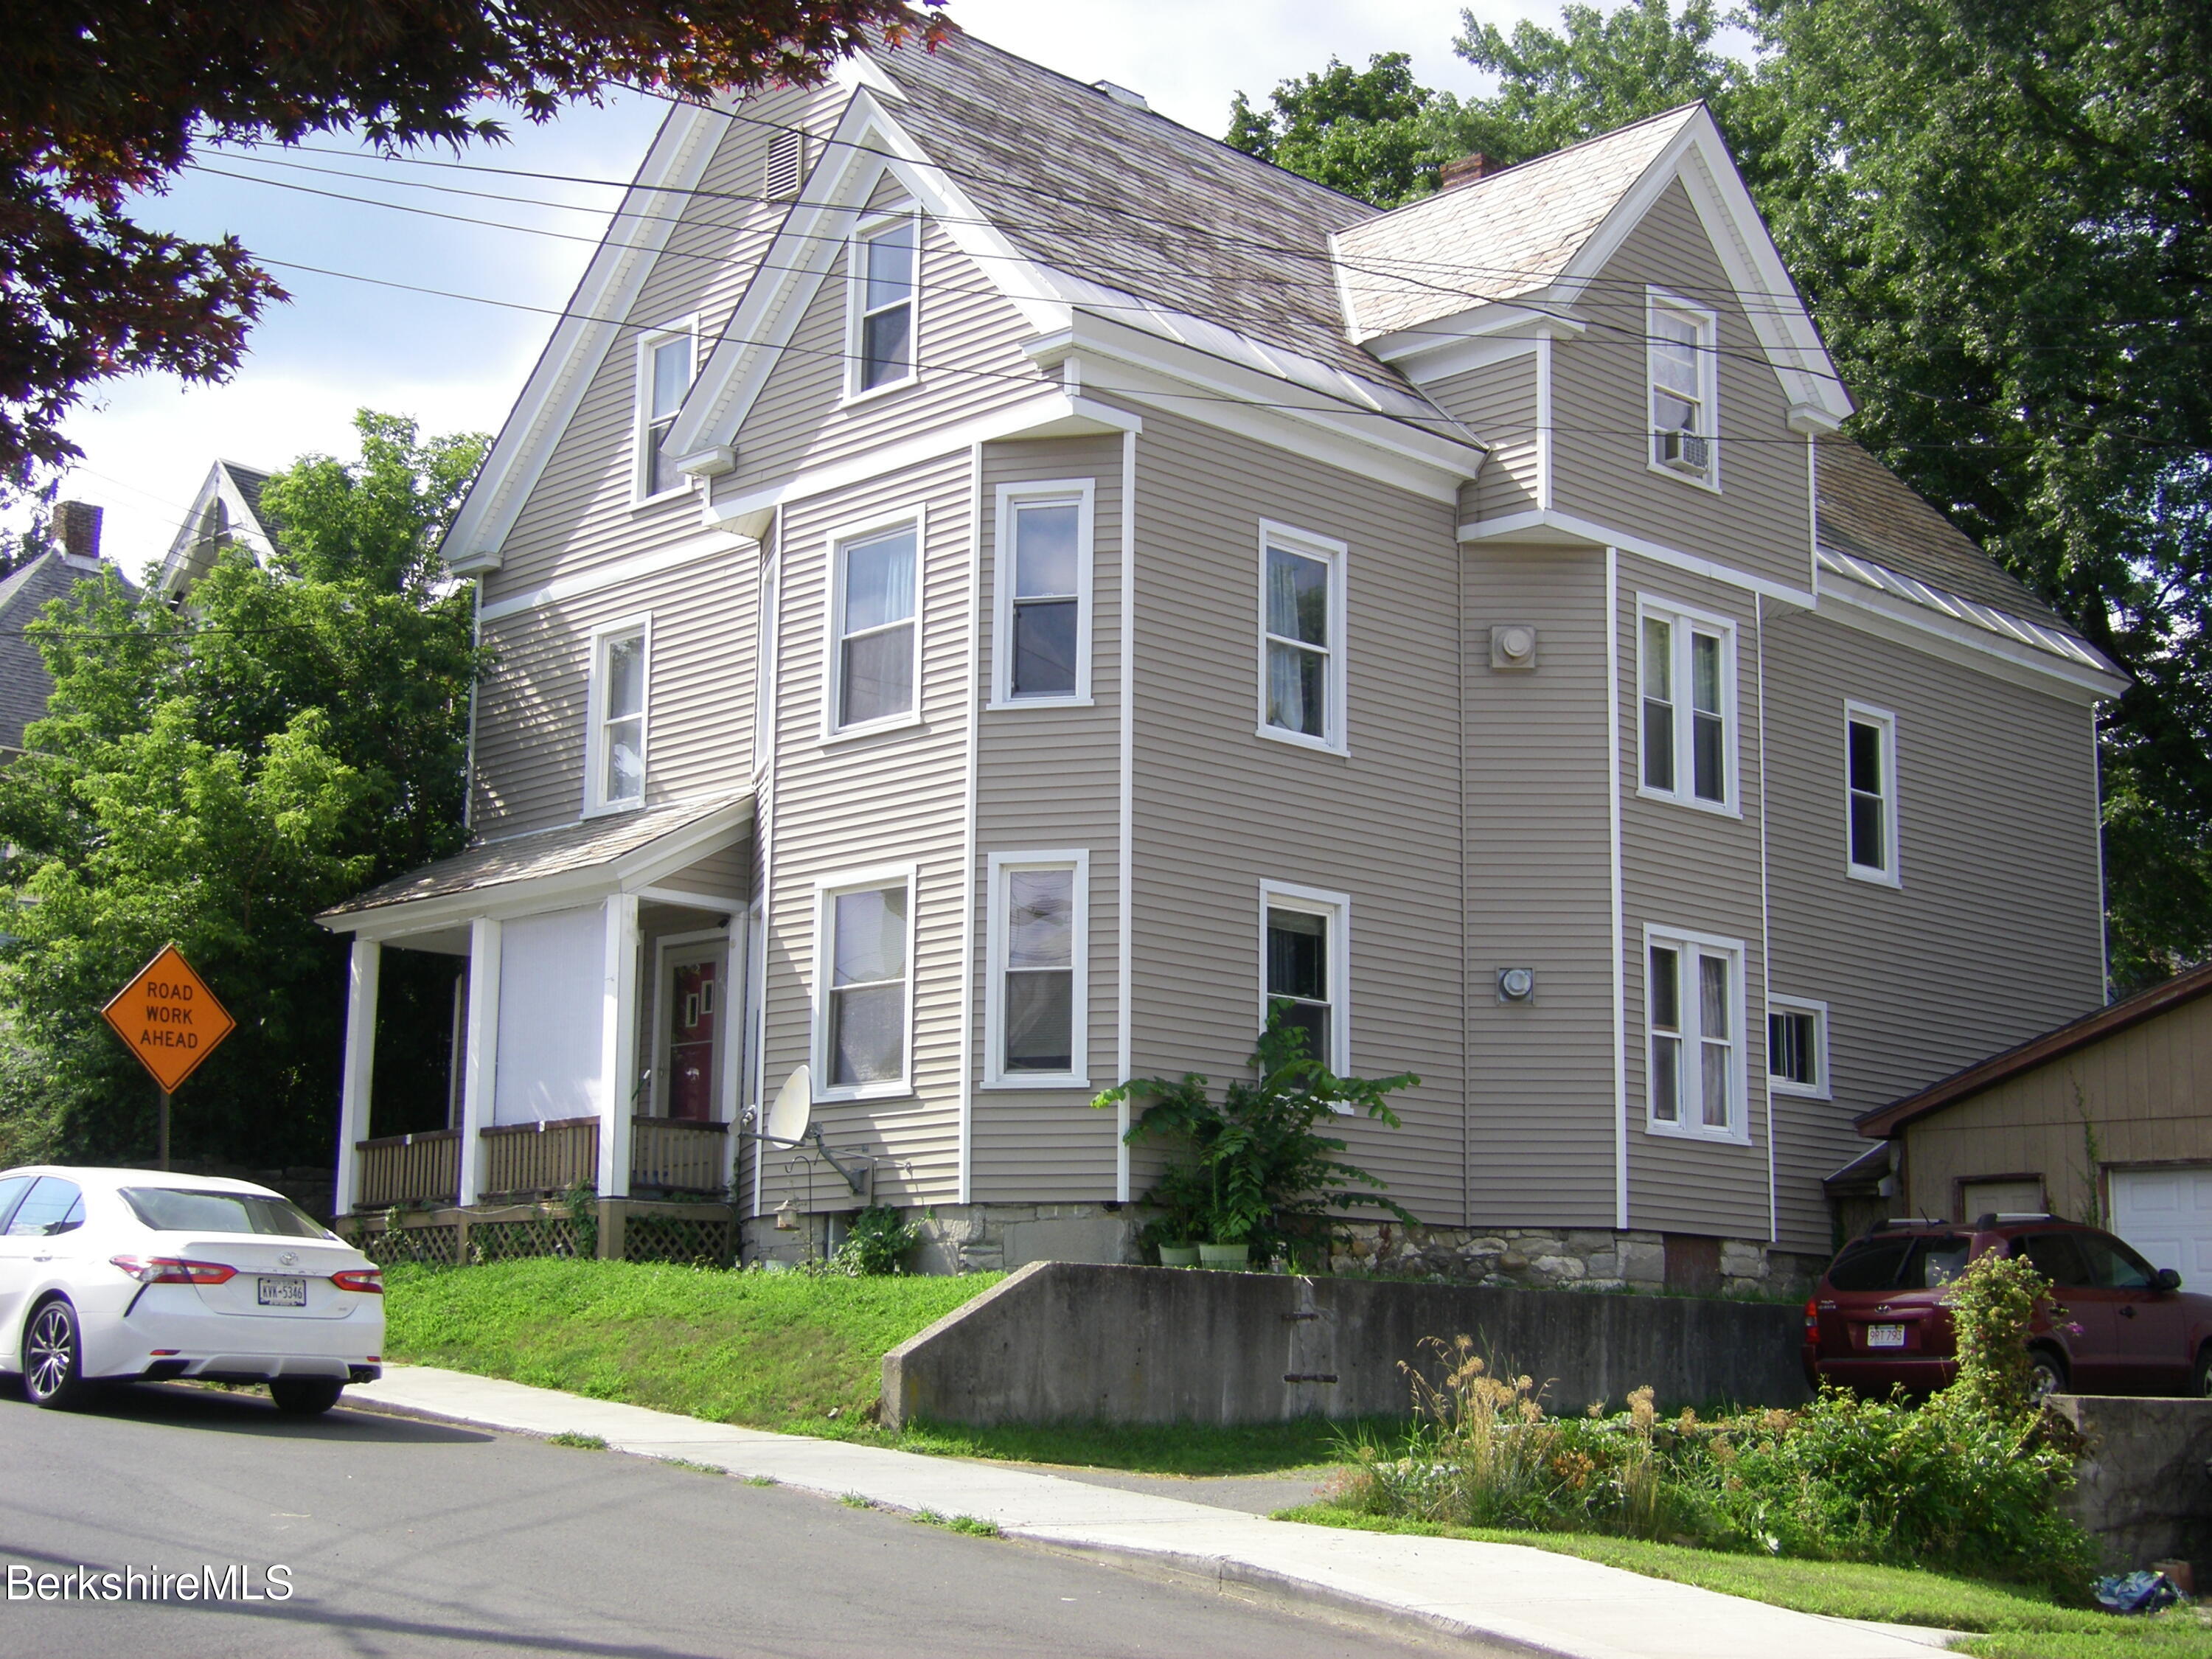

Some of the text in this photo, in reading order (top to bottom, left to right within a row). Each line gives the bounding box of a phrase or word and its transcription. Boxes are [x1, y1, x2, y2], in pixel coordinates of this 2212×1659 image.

[147, 982, 193, 1001] ROAD
[146, 1006, 193, 1025] WORK
[140, 1029, 198, 1048] AHEAD
